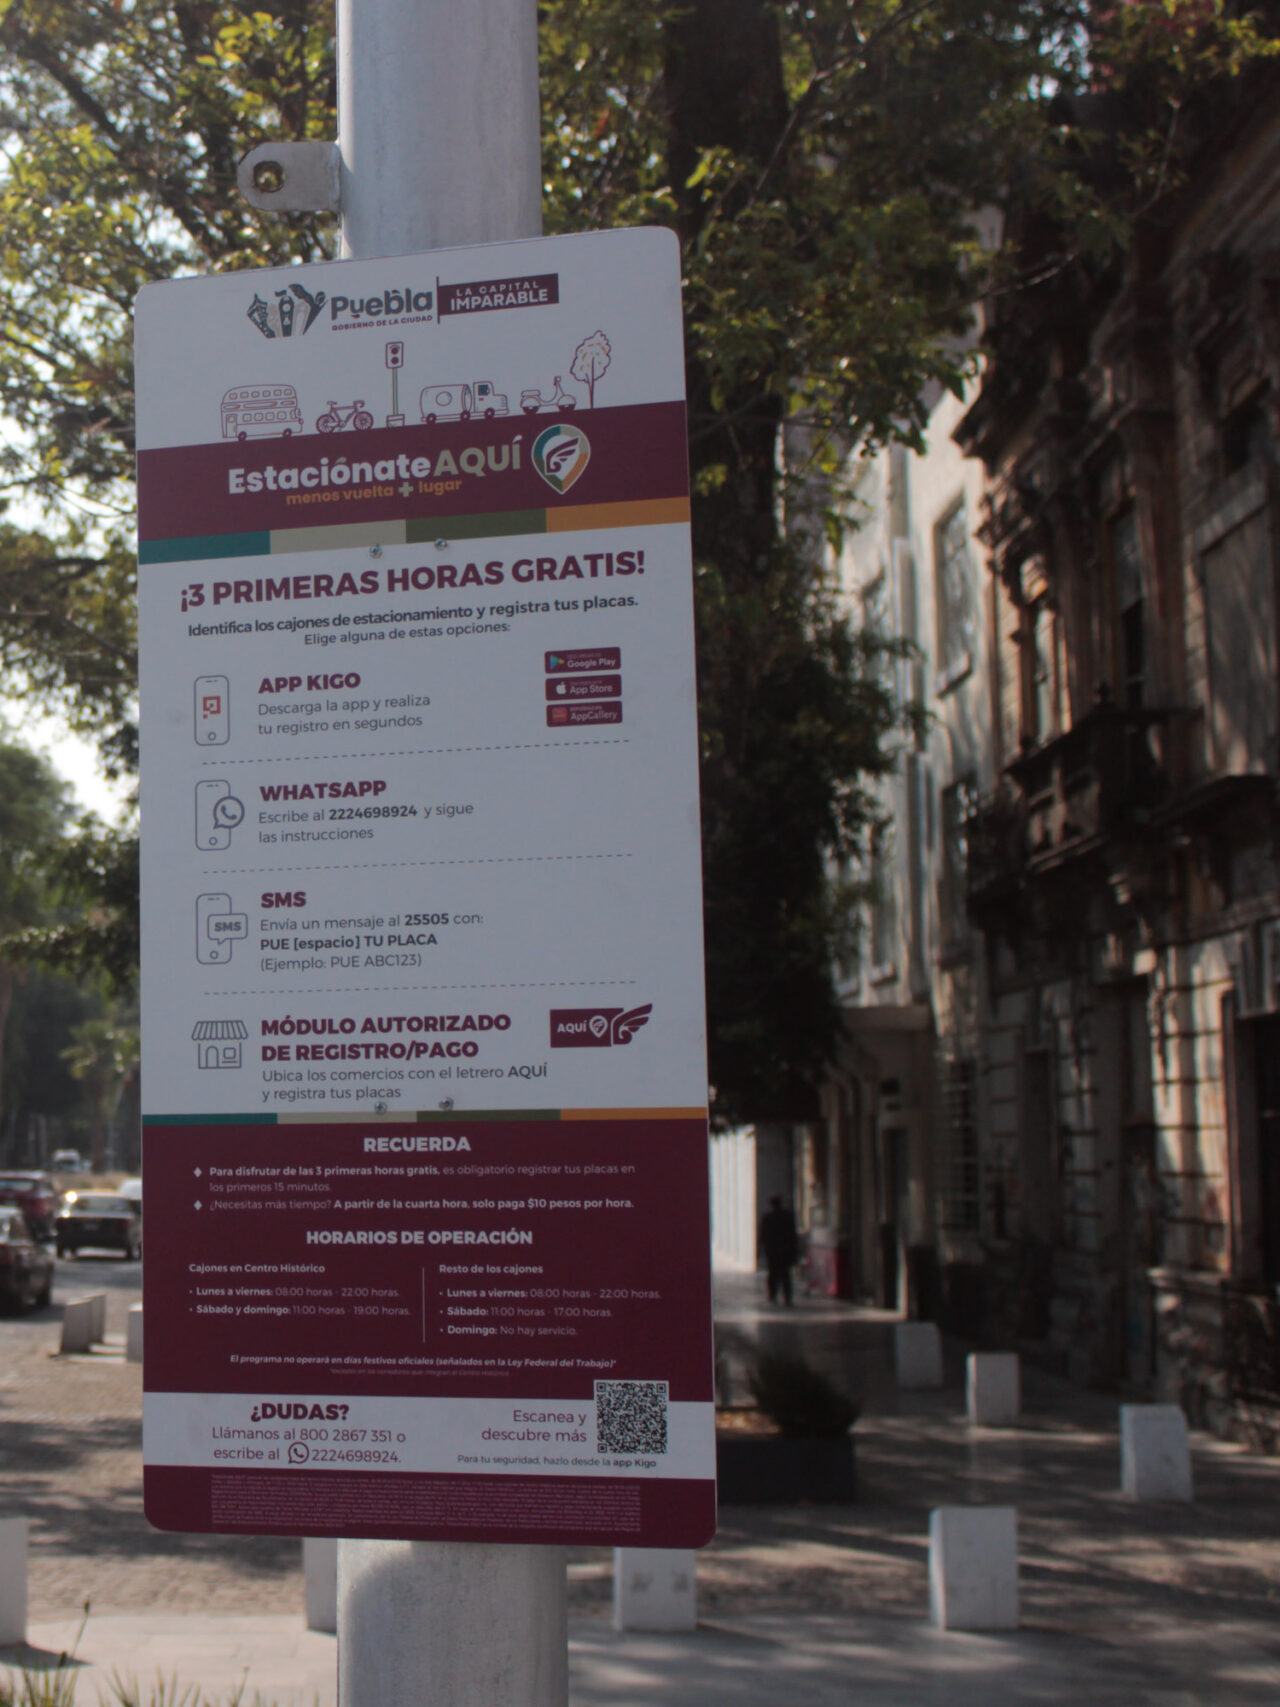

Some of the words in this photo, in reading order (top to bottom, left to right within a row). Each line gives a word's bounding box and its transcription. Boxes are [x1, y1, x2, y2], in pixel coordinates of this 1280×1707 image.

[456, 288, 473, 297] LA
[478, 280, 541, 294] CAPITAL
[331, 288, 433, 320] Puebla
[450, 288, 549, 312] IMPARABLE
[286, 491, 340, 504] menos
[342, 485, 394, 499] vuelta
[418, 479, 462, 496] lugar
[181, 583, 205, 612] ¡3
[213, 571, 379, 604] PRIMERAS
[387, 561, 504, 591] HORAS
[511, 551, 645, 582] GRATIS!
[188, 621, 252, 636] Identifica
[255, 619, 274, 631] los
[276, 617, 330, 632] cajones
[331, 614, 351, 626] de
[352, 607, 473, 624] estacionamiento
[476, 606, 485, 619] y
[489, 601, 550, 617] registra
[553, 599, 579, 611] tus
[583, 596, 638, 611] placas.
[304, 633, 337, 646] Elige
[339, 631, 385, 644] alguna
[388, 628, 406, 639] de
[408, 627, 443, 638] estas
[446, 622, 512, 636] opciones:
[567, 659, 597, 669] Google
[598, 658, 616, 667] Play
[258, 676, 302, 693] APP
[307, 672, 361, 690] KIGO
[570, 686, 588, 695] App
[589, 684, 613, 693] Store
[258, 703, 322, 715] Descarga
[326, 699, 338, 711] la
[342, 700, 370, 712] app
[372, 699, 381, 711] y
[384, 694, 430, 707] realiza
[258, 724, 272, 734] tu
[276, 722, 329, 735] registro
[332, 720, 350, 730] en
[354, 715, 423, 731] segundos
[259, 780, 386, 801] WHATSAPP
[258, 811, 309, 824] Escribe
[312, 809, 324, 821] al
[329, 805, 417, 820] 2224698924
[424, 807, 431, 818] y
[436, 804, 474, 817] sigue
[259, 831, 277, 843] las
[281, 829, 374, 841] instrucciones
[260, 891, 306, 908] SMS
[214, 921, 242, 932] SMS
[260, 918, 297, 931] Envía
[301, 920, 320, 930] un
[324, 918, 384, 929] mensaje
[388, 915, 400, 926] al
[404, 913, 449, 926] 25505
[453, 914, 484, 924] con:
[260, 938, 290, 950] PUE
[293, 935, 360, 951] [espacio]
[363, 935, 383, 947] TU
[387, 933, 437, 946] PLACA
[260, 957, 325, 972] (Ejemplo:
[330, 955, 360, 968] PUE
[363, 953, 421, 967] ABC123)
[261, 1015, 356, 1035] MÓDULO
[360, 1014, 511, 1033] AUTORIZADO
[557, 1020, 587, 1033] AQUÍ
[261, 1045, 291, 1061] DE
[295, 1041, 479, 1060] REGISTRO/PAGO
[262, 1070, 303, 1082] Ubica
[307, 1069, 326, 1081] los
[330, 1070, 404, 1080] comercios
[407, 1069, 435, 1079] con
[439, 1066, 451, 1079] el
[456, 1066, 504, 1078] letrero
[507, 1062, 547, 1079] AQUÍ
[262, 1090, 270, 1103] y
[273, 1088, 326, 1102] registra
[330, 1088, 351, 1099] tus
[355, 1086, 401, 1103] placas
[363, 1136, 471, 1152] RECUERDA
[209, 1167, 233, 1176] Para
[235, 1166, 280, 1176] disfrutar
[282, 1166, 297, 1175] de
[298, 1166, 314, 1175] las
[315, 1166, 322, 1175] 3
[324, 1166, 372, 1176] primeras
[374, 1165, 405, 1175] horas
[406, 1165, 440, 1177] gratis,
[333, 1199, 342, 1208] A
[344, 1199, 374, 1210] partir
[376, 1199, 391, 1208] de
[392, 1199, 403, 1208] la
[404, 1200, 440, 1208] cuarta
[442, 1199, 470, 1208] hora,
[472, 1199, 495, 1208] solo
[497, 1200, 525, 1210] paga
[527, 1197, 547, 1208] $10
[549, 1200, 581, 1209] pesos
[583, 1200, 603, 1209] por
[605, 1198, 634, 1207] hora.
[306, 1230, 398, 1244] HORARIOS
[400, 1230, 424, 1244] DE
[427, 1228, 533, 1244] OPERACIÓN
[188, 1263, 228, 1273] Cajones
[243, 1263, 278, 1272] Centro
[280, 1263, 325, 1272] Histórico
[439, 1264, 469, 1273] Resto
[470, 1264, 484, 1273] de
[486, 1264, 501, 1273] los
[502, 1264, 543, 1275] cajones
[196, 1287, 225, 1295] Lunes
[235, 1287, 273, 1296] viernes:
[446, 1288, 477, 1297] Lunes
[487, 1288, 528, 1297] viernes:
[196, 1304, 234, 1313] Sábado
[235, 1306, 241, 1316] y
[242, 1305, 290, 1316] domingo:
[447, 1306, 488, 1316] Sábado:
[447, 1325, 497, 1336] Domingo:
[250, 1403, 349, 1422] ¿DUDAS?
[513, 1409, 574, 1423] Escanea
[578, 1414, 586, 1426] y
[212, 1426, 280, 1440] Llámanos
[283, 1428, 296, 1440] al
[300, 1428, 329, 1441] 800
[332, 1429, 367, 1441] 2867
[370, 1429, 392, 1442] 351
[396, 1432, 406, 1443] o
[481, 1428, 551, 1441] descubre
[555, 1429, 587, 1442] más
[213, 1447, 264, 1459] escribe
[267, 1448, 279, 1460] al
[312, 1449, 402, 1464] 2224698924.
[457, 1454, 478, 1463] Para
[480, 1455, 491, 1463] tu
[543, 1456, 569, 1465] hazlo
[570, 1457, 600, 1466] desde
[602, 1458, 611, 1466] la
[612, 1459, 632, 1468] app
[634, 1459, 657, 1469] Kigo
